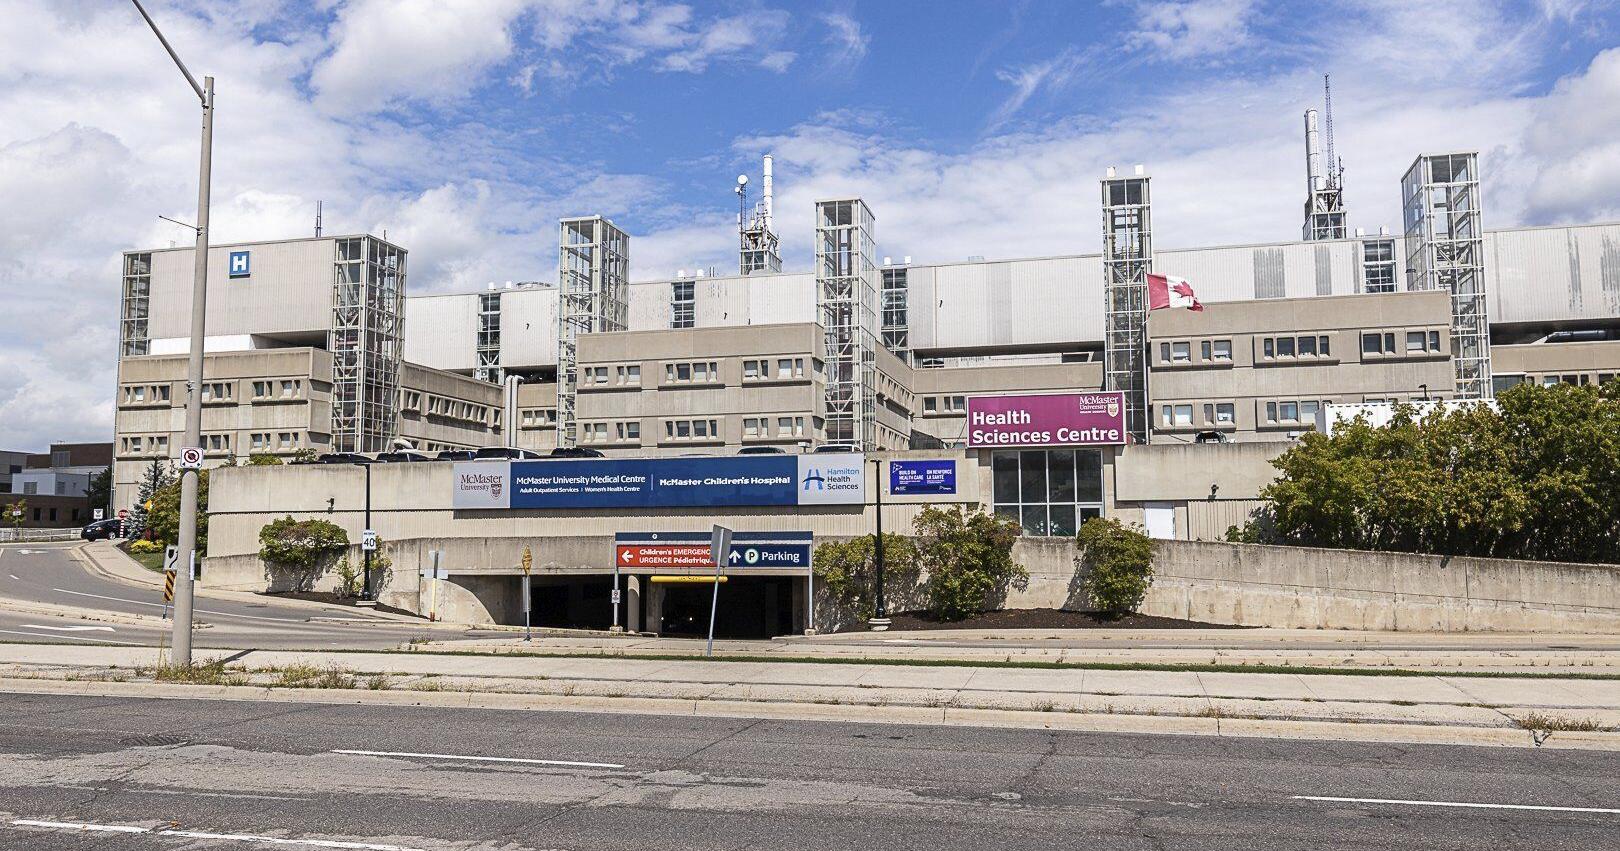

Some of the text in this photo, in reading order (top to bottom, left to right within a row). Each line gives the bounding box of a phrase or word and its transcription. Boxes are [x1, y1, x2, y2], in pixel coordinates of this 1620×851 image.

[233, 255, 247, 271] H
[1080, 395, 1118, 404] McMaster
[1080, 404, 1107, 412] University
[972, 410, 1031, 425] Health
[972, 427, 1119, 444] Sciences Centre
[460, 474, 502, 484] McMaster
[516, 475, 646, 485] McMaster University Medical Centre
[659, 476, 791, 486] McMaster Children's Hospital
[363, 537, 375, 547] 40
[673, 557, 713, 565] Pédiatriqu
[761, 551, 800, 563] Parking
